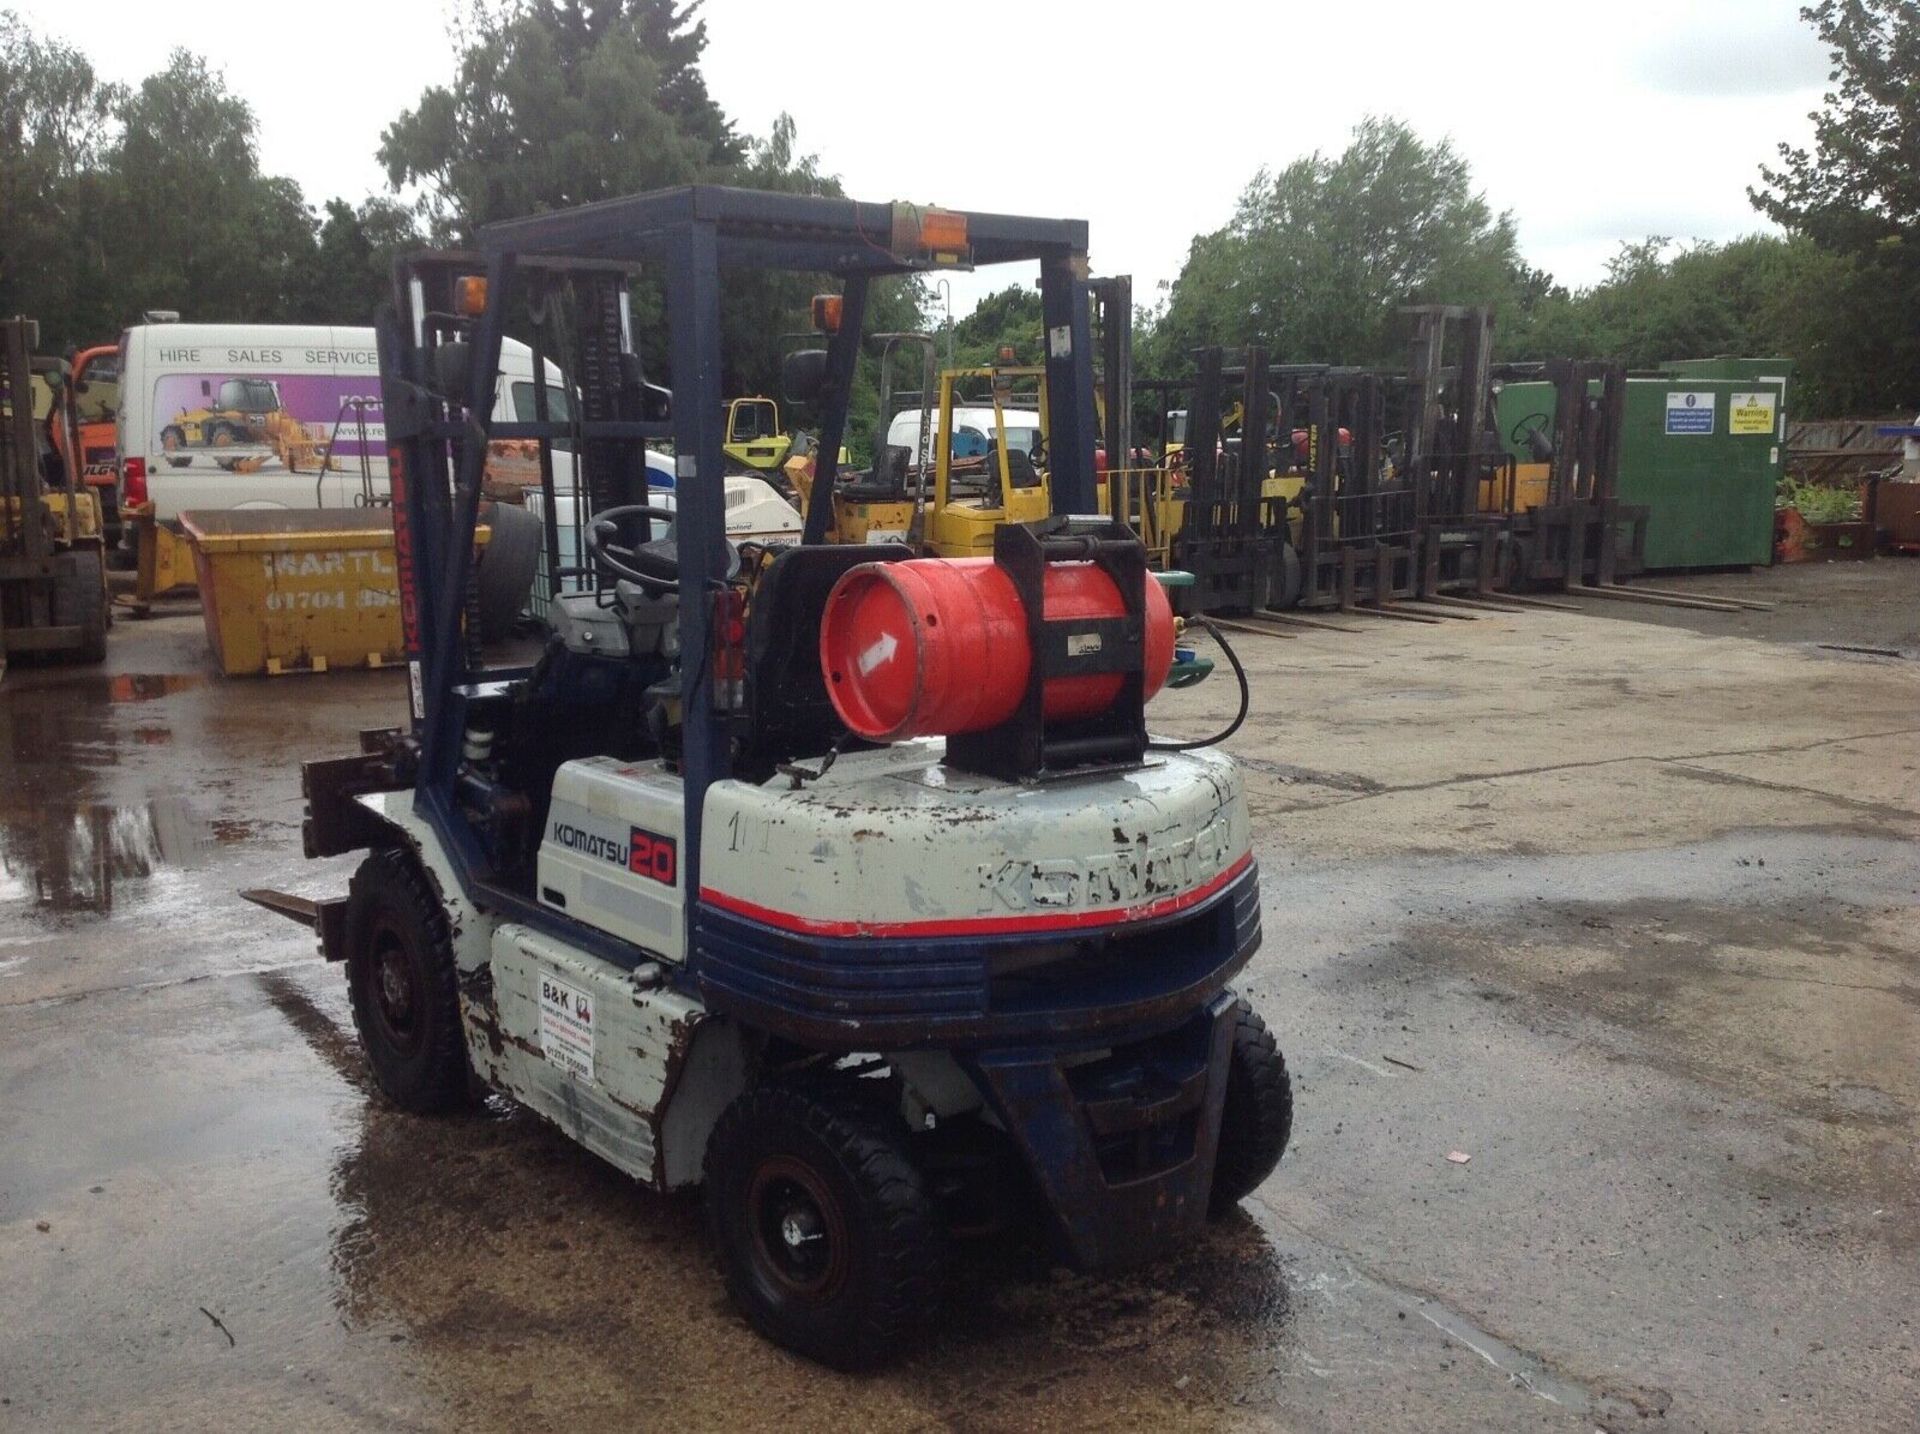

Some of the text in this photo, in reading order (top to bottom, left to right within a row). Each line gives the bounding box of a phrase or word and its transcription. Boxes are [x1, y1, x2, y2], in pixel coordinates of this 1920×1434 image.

[159, 350, 379, 365] HIRE SALES SERVICE
[1735, 408, 1769, 419] Warning
[1309, 424, 1318, 472] HYSTER
[262, 550, 399, 578] MARTL
[553, 822, 674, 883] KOMATSU 20
[543, 981, 569, 1011] B&K
